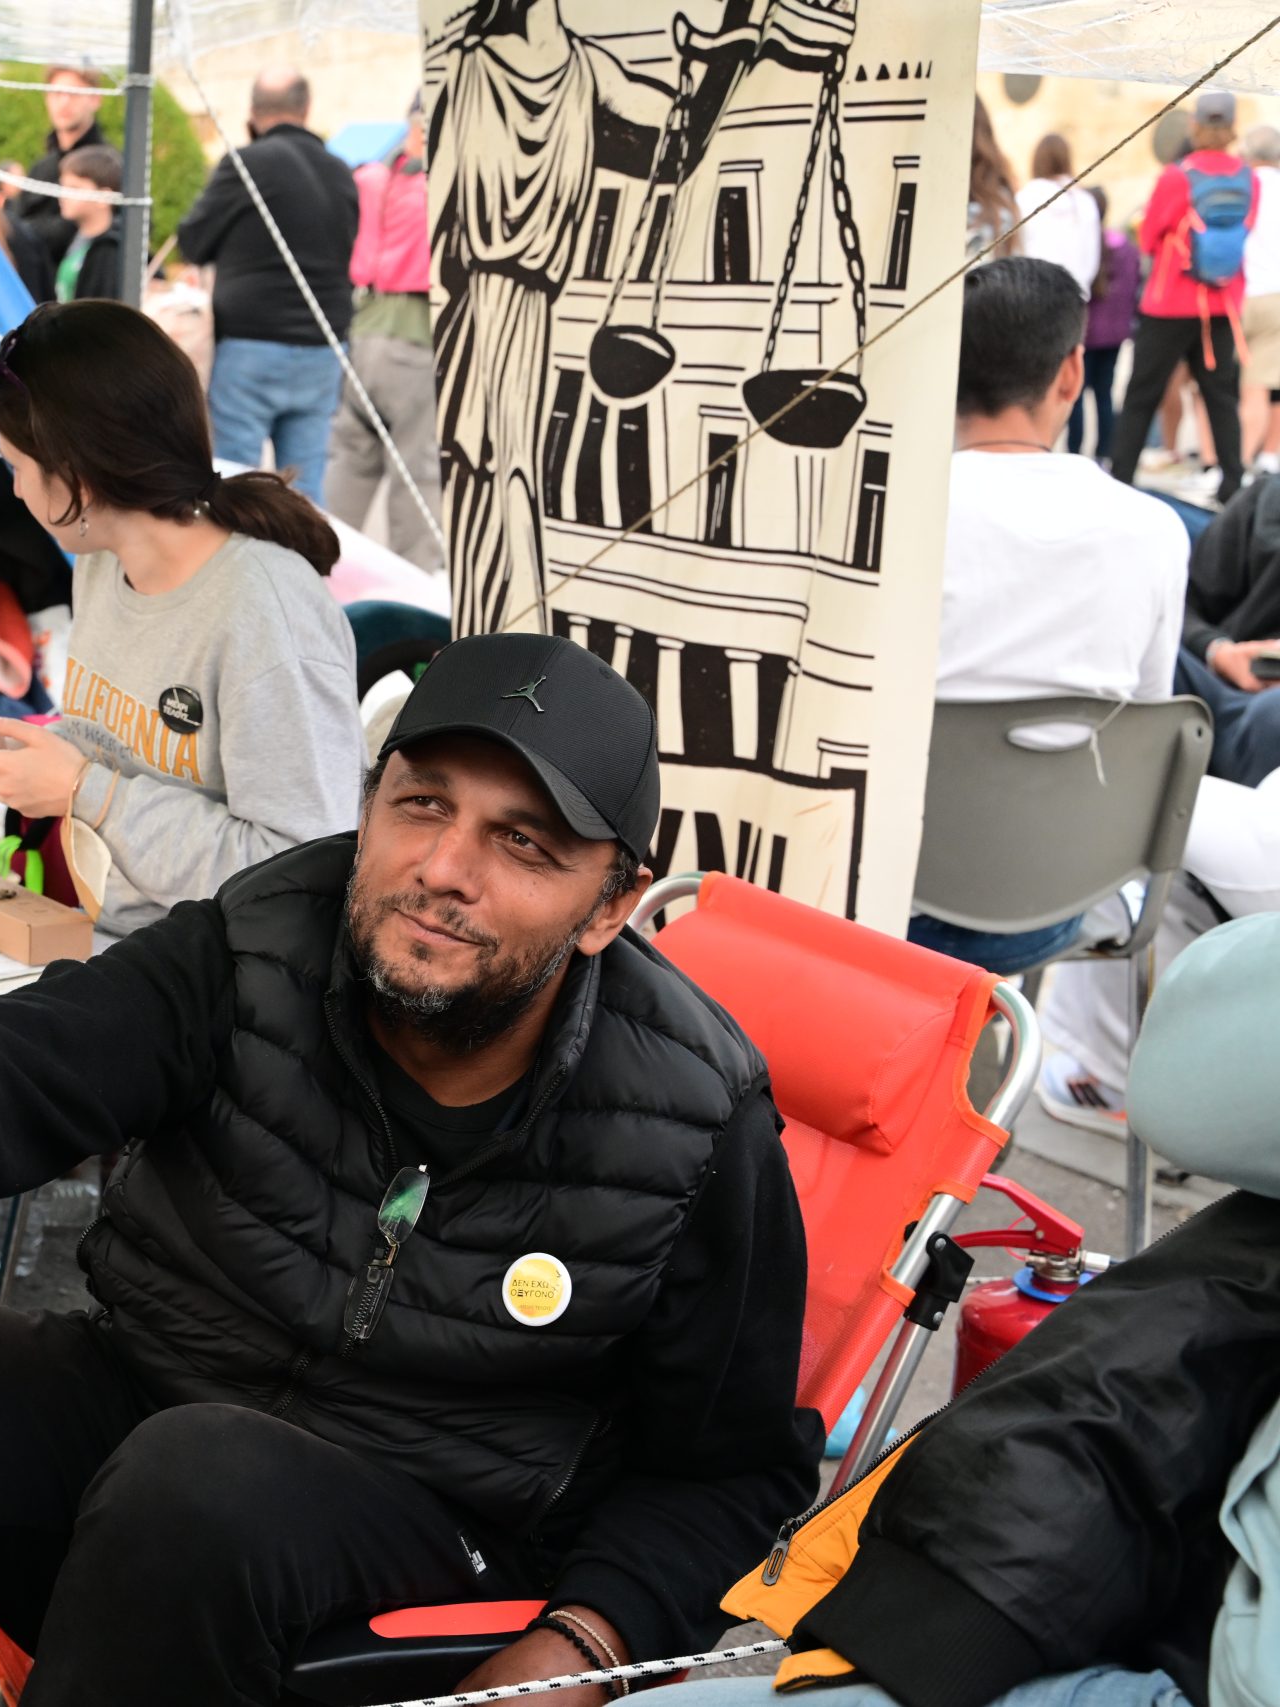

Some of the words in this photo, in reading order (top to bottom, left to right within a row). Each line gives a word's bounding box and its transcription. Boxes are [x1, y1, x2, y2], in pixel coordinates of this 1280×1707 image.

[512, 1279, 529, 1287] ΔΕΝ
[531, 1280, 549, 1288] ΕΧΩ
[510, 1288, 554, 1299] ΟΞΥΓΟΝΟ
